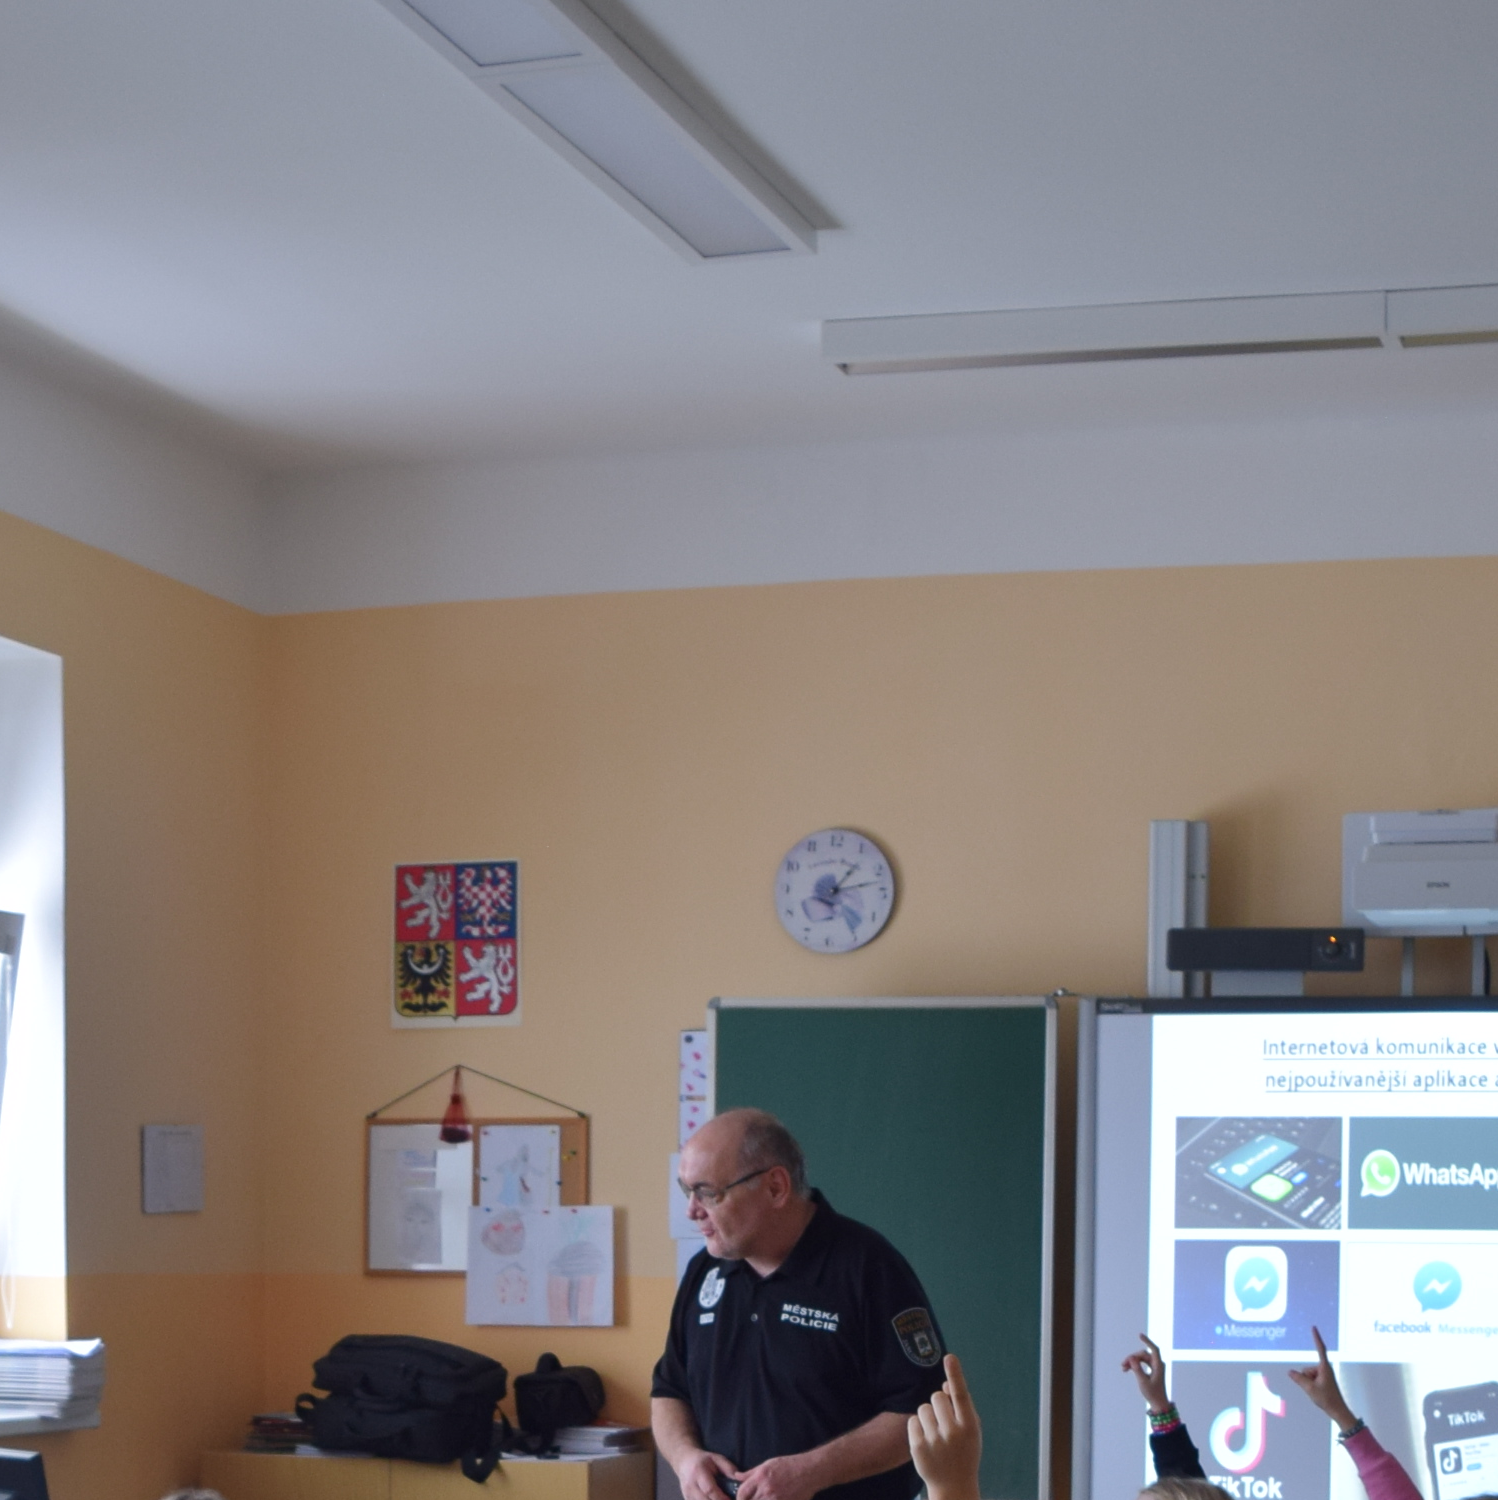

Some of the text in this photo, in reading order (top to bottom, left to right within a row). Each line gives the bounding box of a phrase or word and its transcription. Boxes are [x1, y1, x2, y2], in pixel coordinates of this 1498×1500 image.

[1263, 1038, 1369, 1056] Internetová
[1376, 1037, 1487, 1055] komunikace
[1266, 1070, 1406, 1092] nejpoužívanější
[1413, 1070, 1488, 1092] aplikace
[780, 1313, 838, 1332] POLICIE
[782, 1303, 840, 1323] MĚSTSKÁ
[1223, 1324, 1287, 1341] Messenger
[1374, 1320, 1432, 1333] facebook
[1447, 1410, 1486, 1427] TikTok
